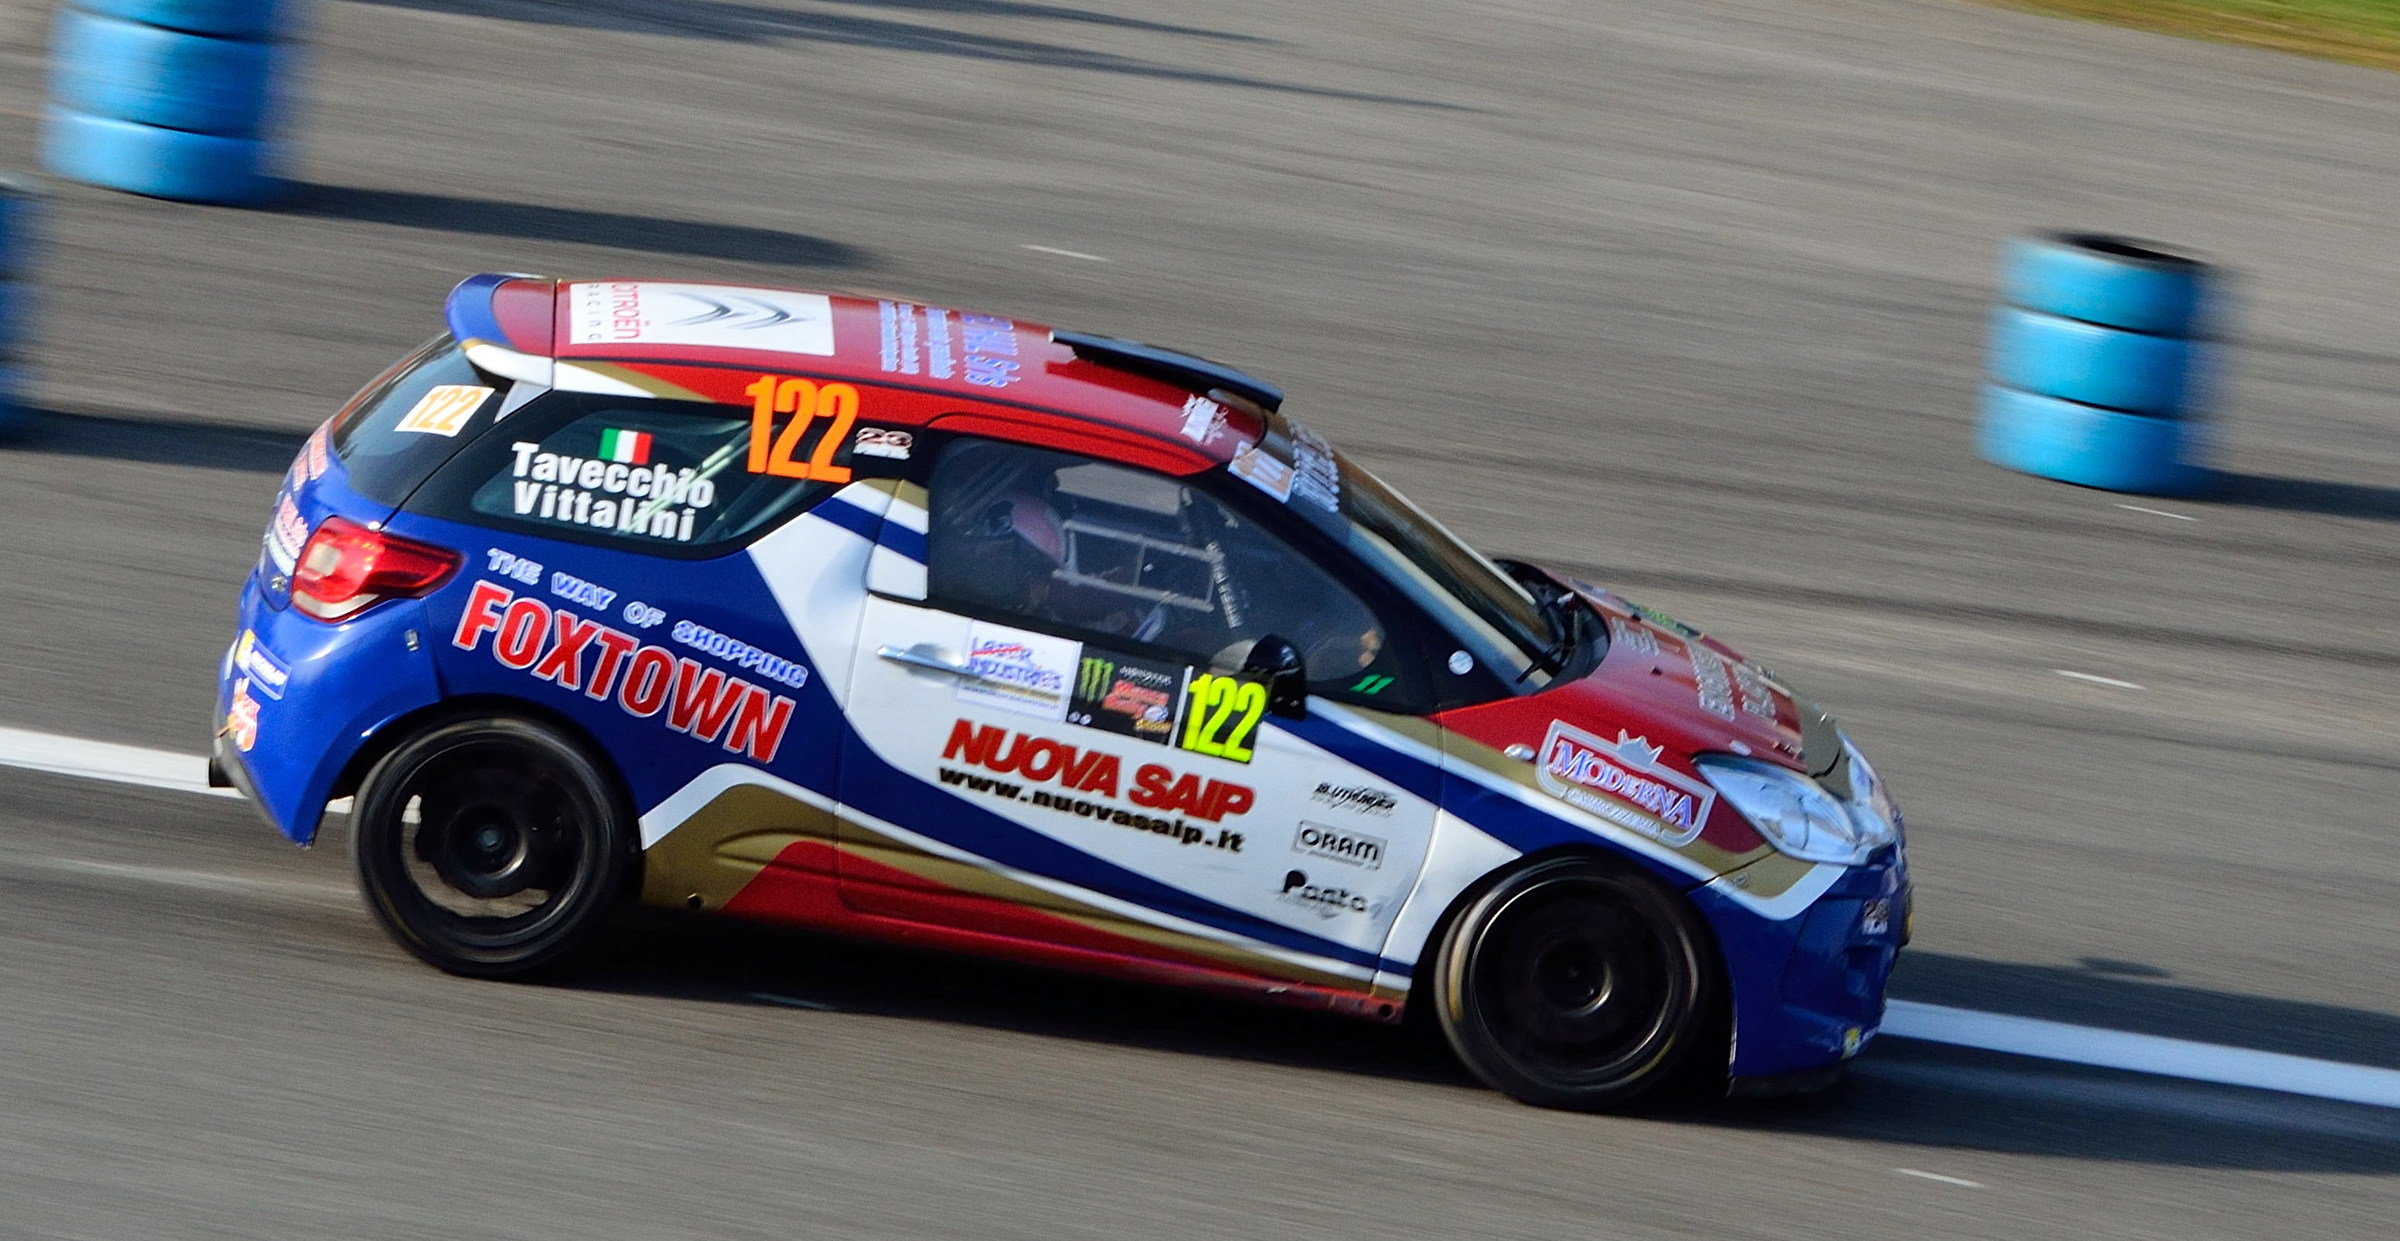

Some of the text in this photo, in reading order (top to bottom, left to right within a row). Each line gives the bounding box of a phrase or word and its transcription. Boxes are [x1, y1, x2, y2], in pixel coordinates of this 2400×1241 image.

[407, 386, 483, 432] 122
[744, 374, 859, 484] 122
[512, 441, 715, 509] Tavecchio
[514, 481, 696, 542] Vittalini
[487, 548, 809, 689] THE WAY OF SHOPPING
[453, 578, 797, 764] FOXTOWN
[1182, 673, 1267, 763] 122
[939, 767, 1246, 852] www.nuovasaip.it
[942, 719, 1256, 822] NUOVA SAIP
[1547, 739, 1694, 830] MODERNA
[1302, 829, 1379, 861] ORAM
